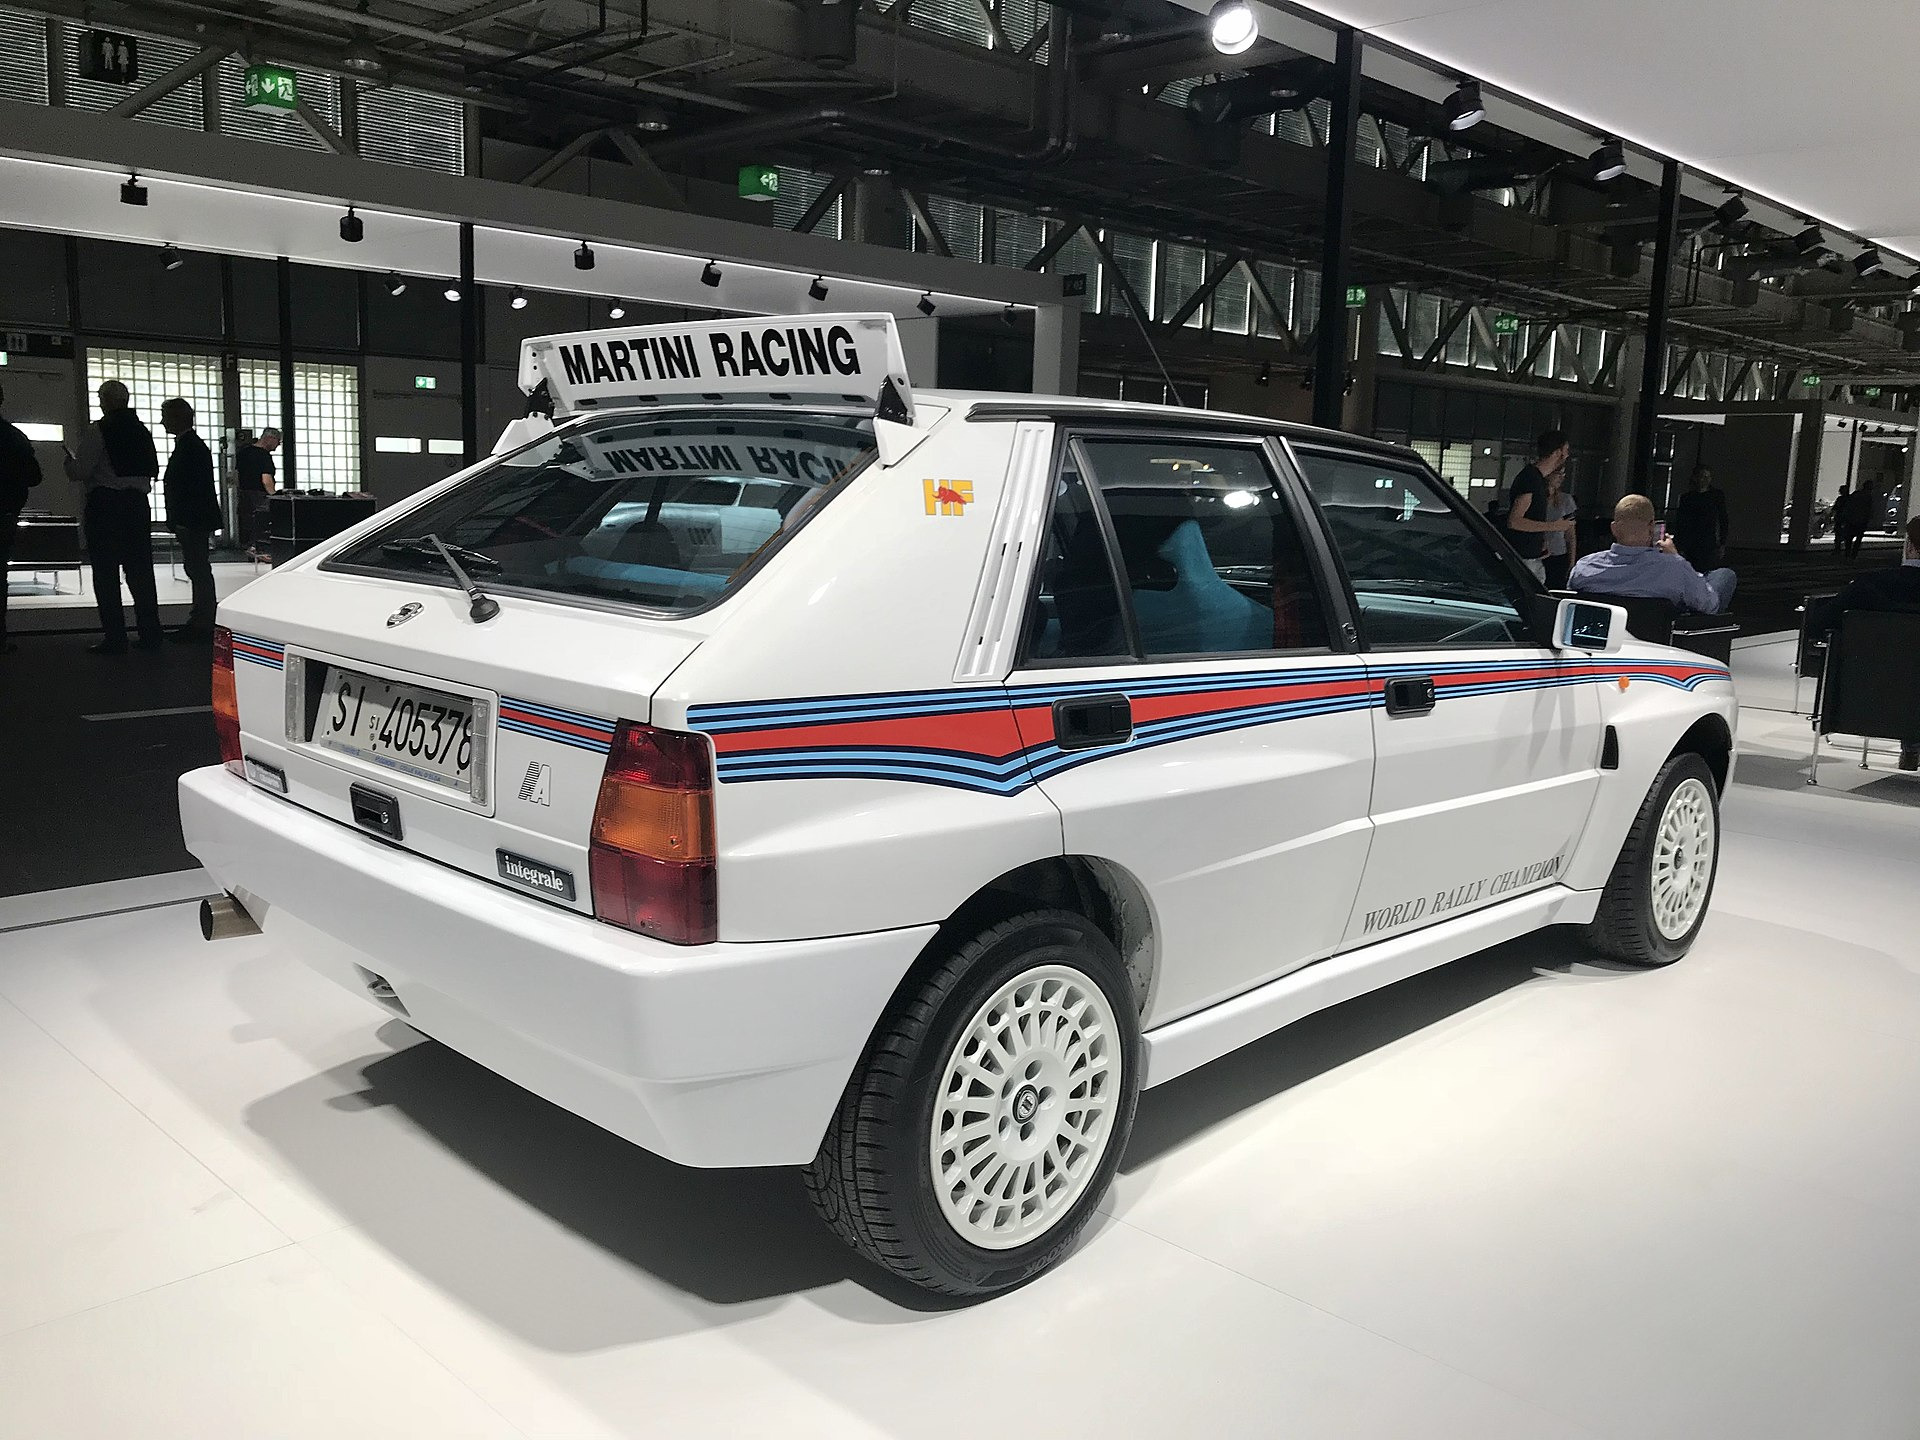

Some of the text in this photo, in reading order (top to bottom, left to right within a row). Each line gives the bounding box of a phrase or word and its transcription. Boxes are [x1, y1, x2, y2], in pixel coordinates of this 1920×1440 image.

[559, 325, 861, 386] MARTINI RACING
[922, 478, 974, 516] HF
[379, 696, 472, 770] 405378
[505, 855, 564, 893] integrale
[1363, 855, 1565, 934] WORLD RALLY CHAMPION
